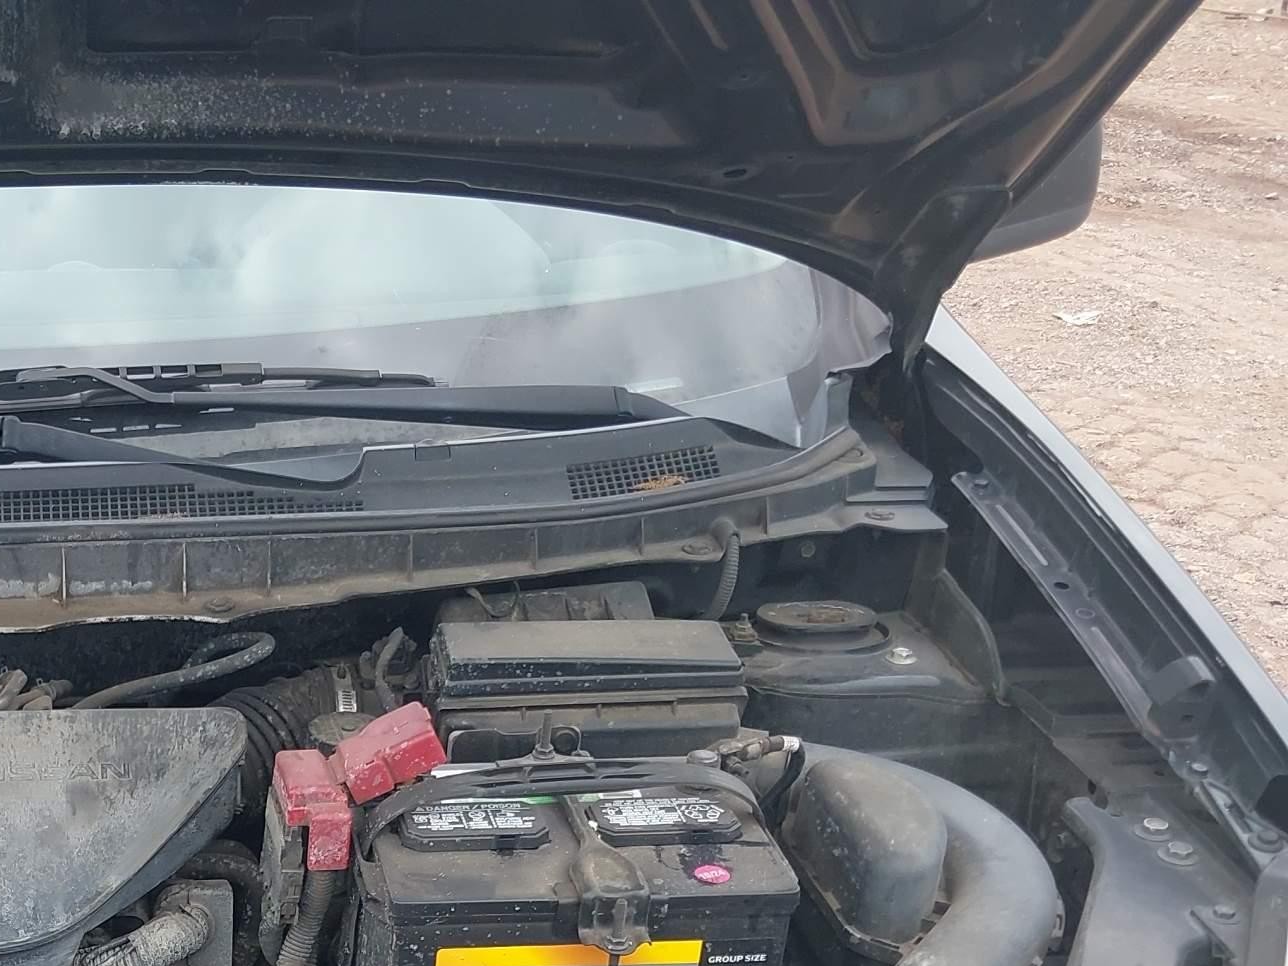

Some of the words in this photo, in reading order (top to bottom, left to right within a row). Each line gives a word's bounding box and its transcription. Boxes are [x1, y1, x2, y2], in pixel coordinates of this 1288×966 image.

[426, 804, 470, 812] DANGER
[708, 954, 744, 964] GROUP
[744, 953, 767, 962] SIZE
